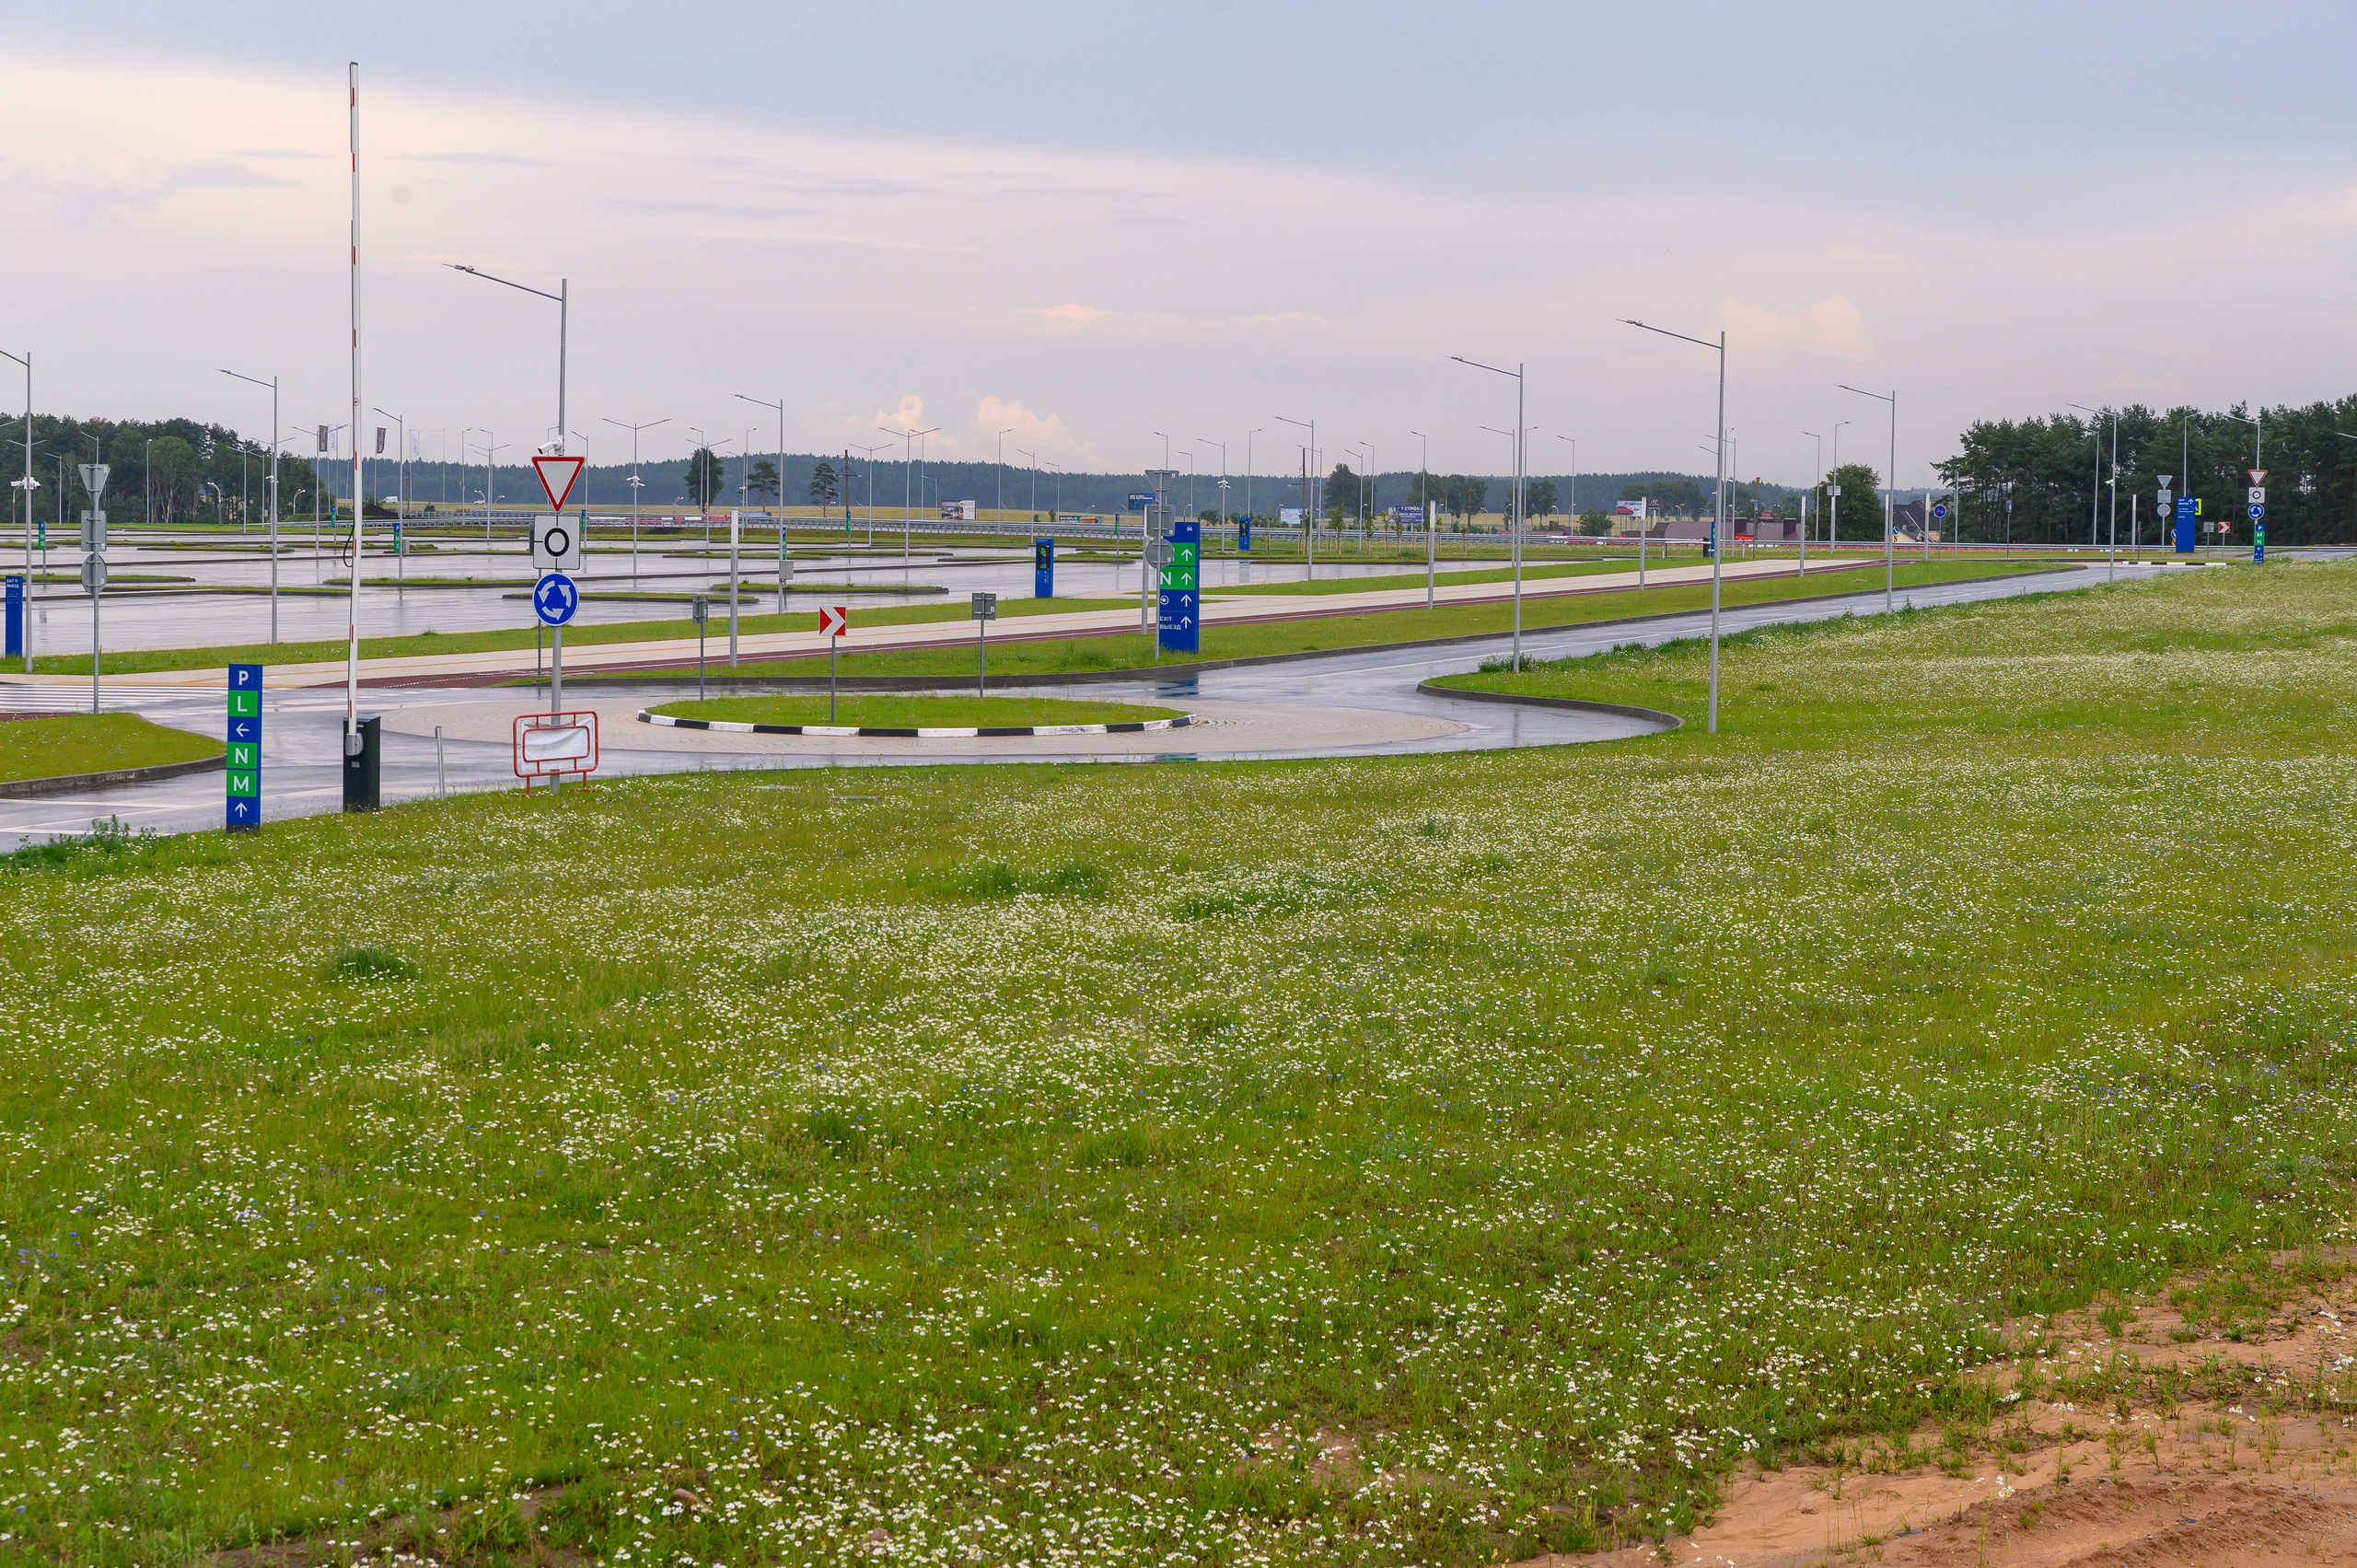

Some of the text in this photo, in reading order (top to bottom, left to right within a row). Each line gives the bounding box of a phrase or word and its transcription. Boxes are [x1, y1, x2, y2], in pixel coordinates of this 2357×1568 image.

[1160, 571, 1171, 586] N
[238, 670, 249, 686] P
[237, 695, 248, 713] L
[235, 748, 249, 764] N
[233, 775, 250, 793] M
